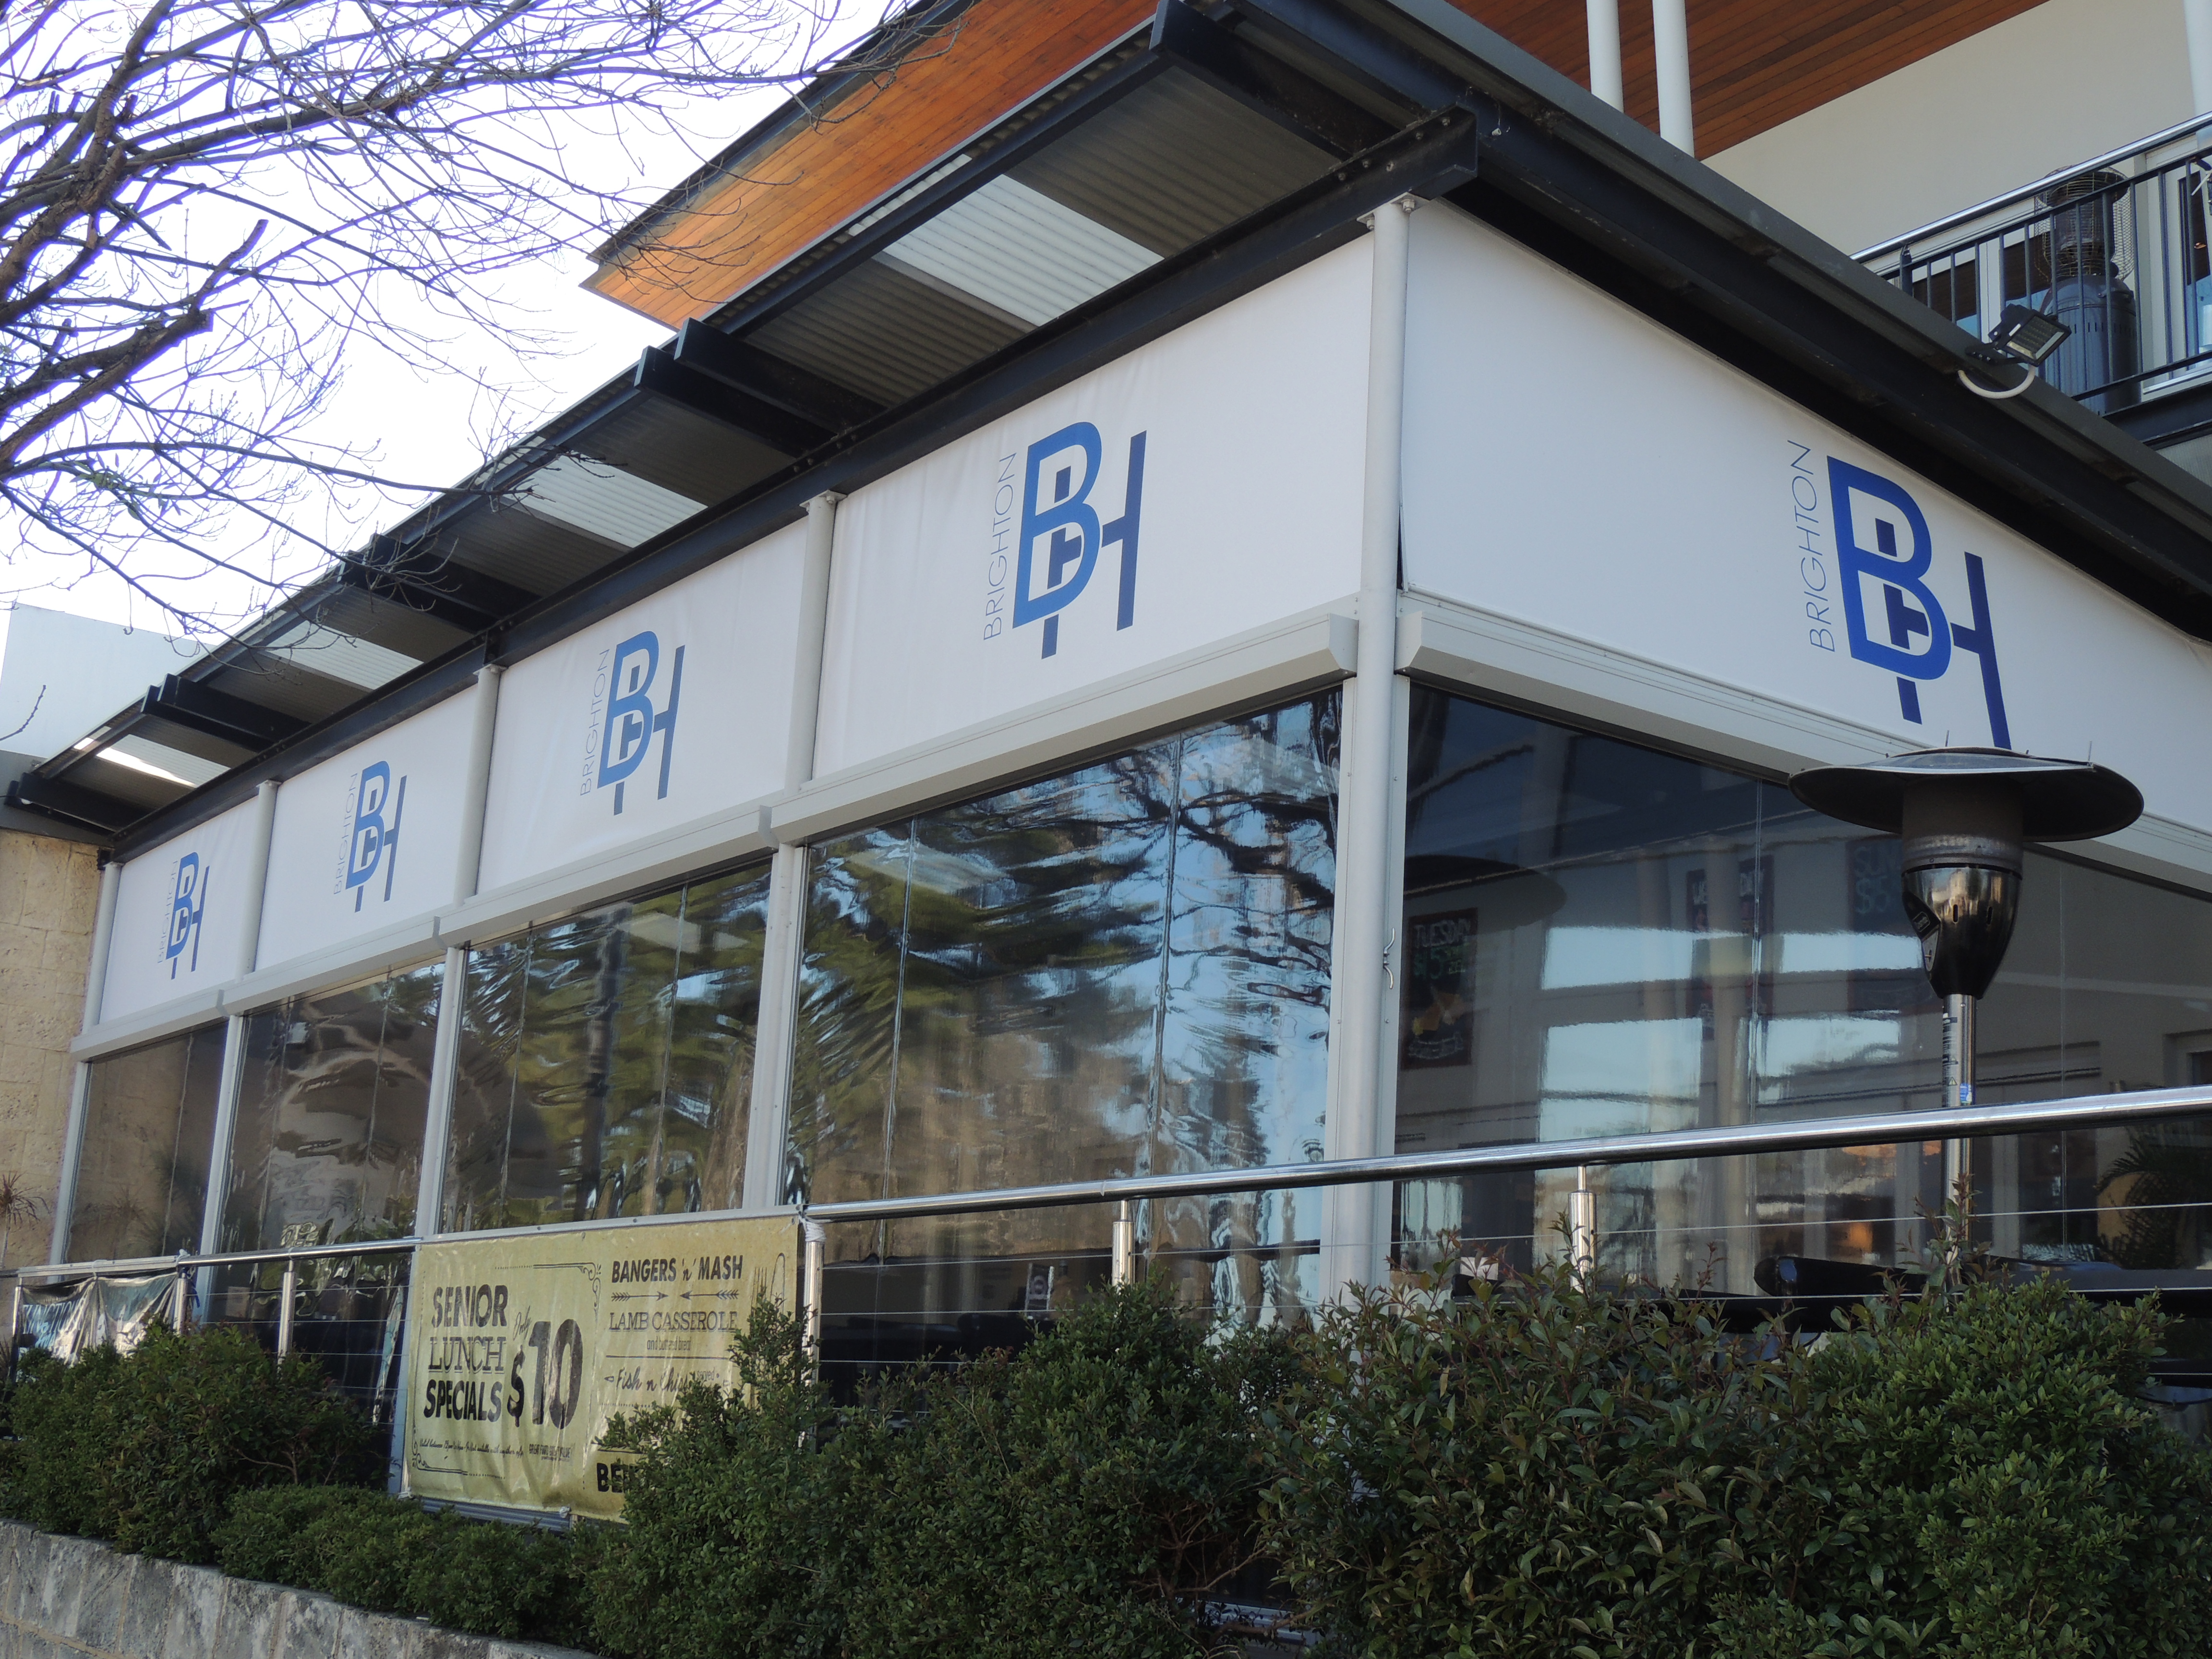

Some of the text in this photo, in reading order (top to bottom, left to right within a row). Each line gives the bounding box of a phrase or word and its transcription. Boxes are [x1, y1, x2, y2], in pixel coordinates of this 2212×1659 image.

[983, 452, 1017, 640] BRIGHTON
[1787, 439, 1835, 652] BRIGHTON
[580, 649, 610, 796] BRIGHTON
[333, 773, 358, 895] BRIGHTON
[612, 1258, 676, 1283] BANGERS
[698, 1255, 743, 1280] MASH
[431, 1284, 508, 1328] SENIOR
[609, 1310, 738, 1333] LAMB CASSEROLE
[428, 1335, 507, 1374] LUNCH
[647, 1336, 658, 1350] and
[507, 1318, 584, 1430] $10
[616, 1366, 642, 1391] Fish
[646, 1379, 658, 1392] n
[423, 1379, 503, 1422] SPECIALS
